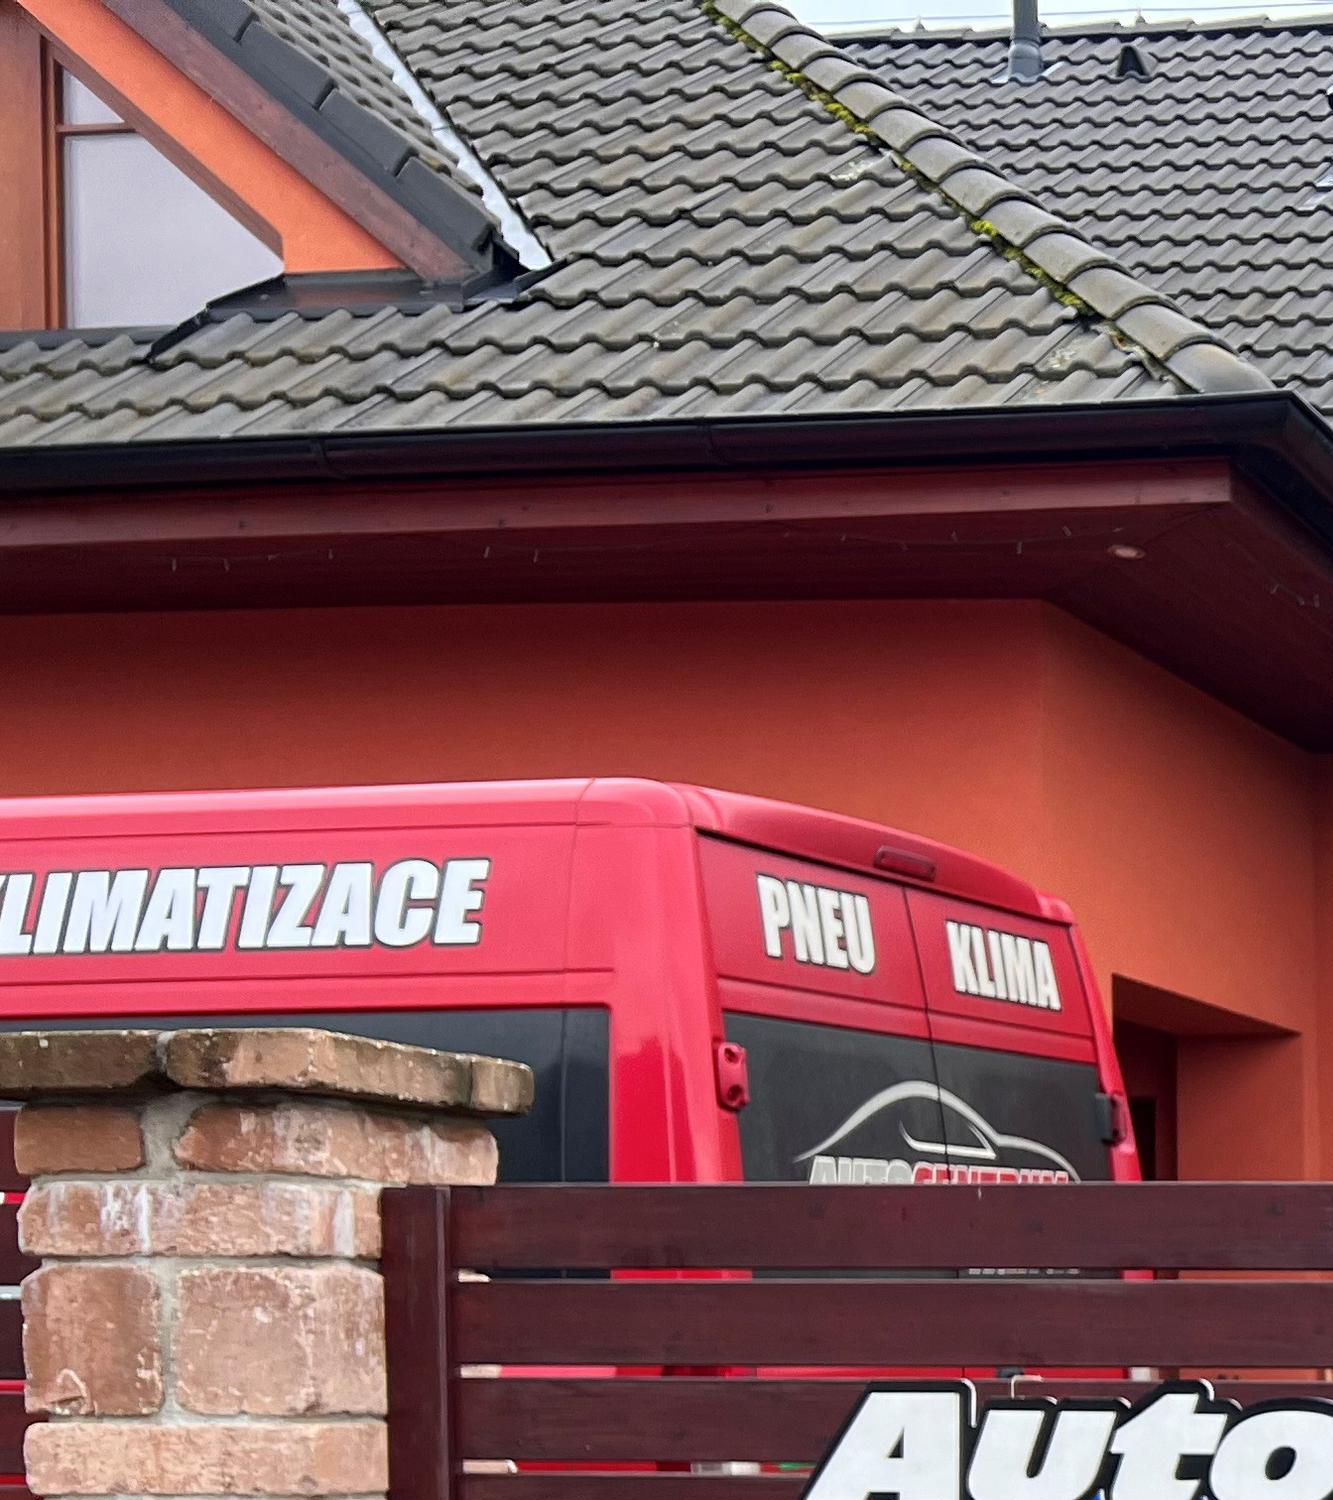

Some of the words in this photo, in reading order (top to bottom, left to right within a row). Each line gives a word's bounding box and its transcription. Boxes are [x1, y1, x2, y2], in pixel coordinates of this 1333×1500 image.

[0, 858, 490, 954] LIMATIZACE
[756, 873, 877, 974] PNEU
[945, 918, 1062, 1010] KLIMA
